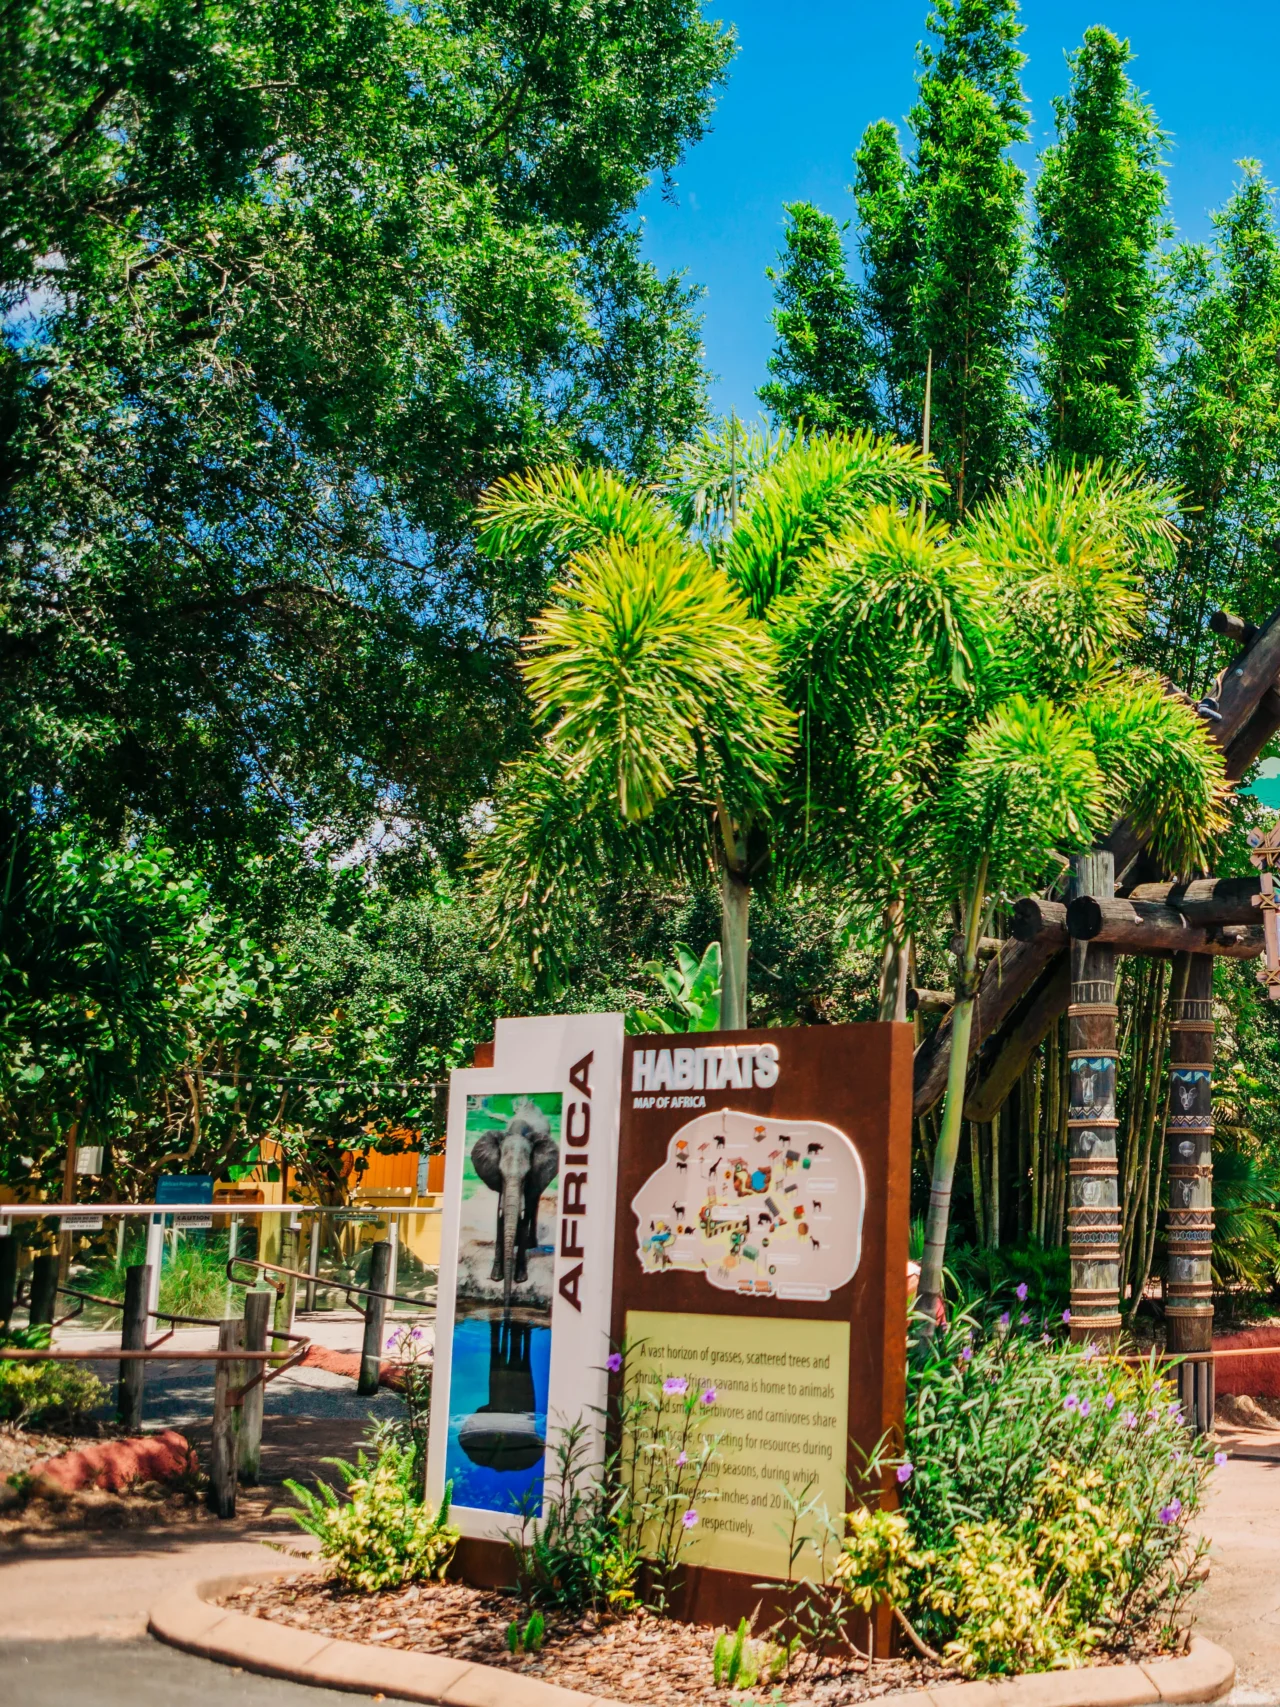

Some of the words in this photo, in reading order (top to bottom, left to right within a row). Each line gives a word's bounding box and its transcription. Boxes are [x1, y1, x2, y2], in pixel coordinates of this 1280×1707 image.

[631, 1042, 780, 1092] HABITATS
[633, 1096, 655, 1109] MAP
[656, 1096, 670, 1108] OF
[670, 1095, 706, 1108] AFRICA
[558, 1049, 595, 1313] AFRICA
[640, 1343, 646, 1357] A
[648, 1345, 665, 1358] vast
[666, 1344, 698, 1360] horizon
[700, 1346, 709, 1361] of
[711, 1349, 744, 1366] grasses,
[746, 1351, 787, 1366] scattered
[788, 1353, 811, 1368] trees
[812, 1354, 830, 1369] and
[714, 1377, 749, 1392] savanna
[751, 1377, 758, 1392] is
[760, 1378, 786, 1394] home
[787, 1381, 797, 1396] to
[799, 1382, 835, 1399] animals
[699, 1403, 745, 1420] Herbivores
[746, 1406, 763, 1421] and
[765, 1408, 810, 1425] carnivores
[812, 1411, 837, 1428] share
[745, 1432, 758, 1449] for
[760, 1438, 801, 1454] resources
[803, 1440, 833, 1460] during
[722, 1461, 759, 1480] seasons,
[761, 1463, 790, 1485] during
[792, 1467, 820, 1484] which
[721, 1487, 749, 1505] inches
[751, 1491, 768, 1508] and
[769, 1494, 781, 1509] 20
[701, 1516, 755, 1538] respectively.
